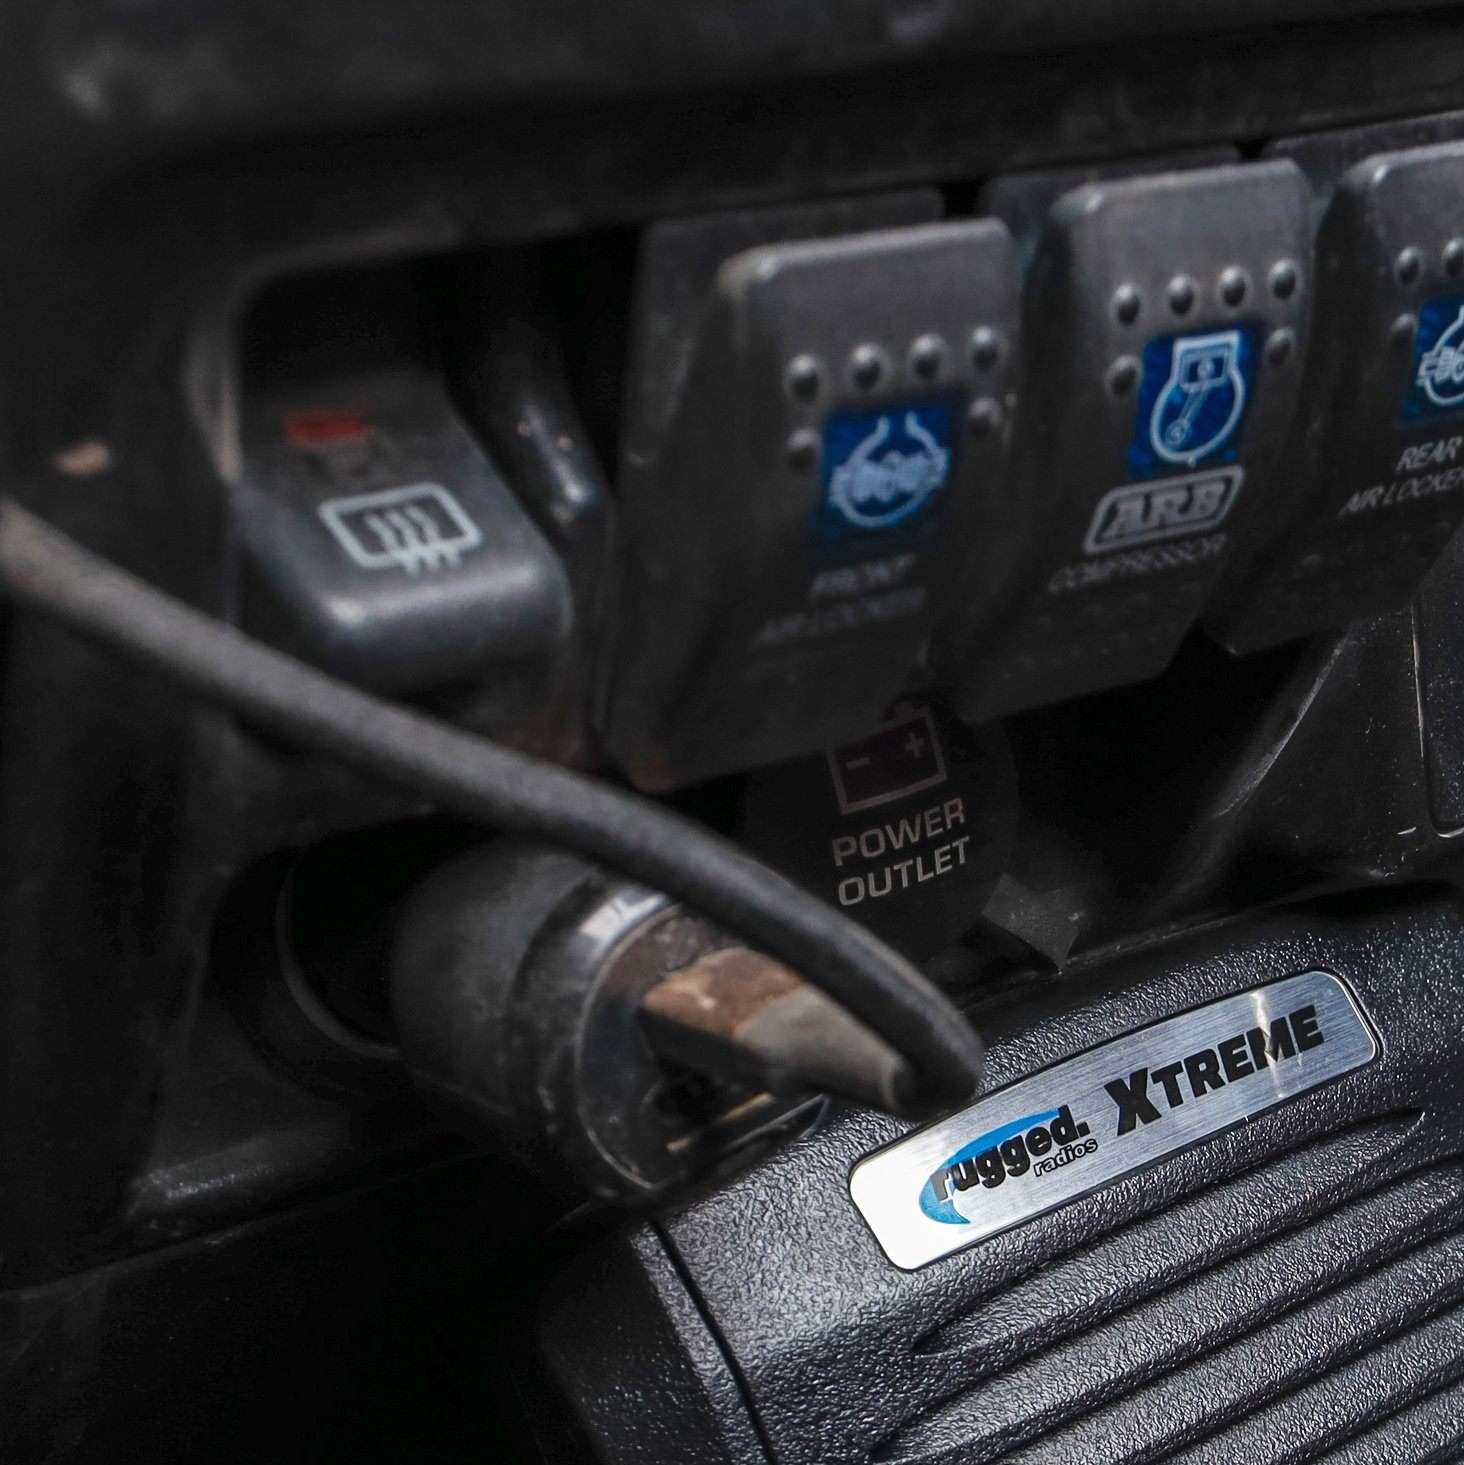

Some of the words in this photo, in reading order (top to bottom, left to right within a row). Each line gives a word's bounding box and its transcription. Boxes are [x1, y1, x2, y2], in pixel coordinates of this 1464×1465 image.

[1395, 435, 1463, 474] REAR
[1094, 477, 1233, 544] ARB
[832, 797, 966, 867] POWER
[838, 835, 970, 906] OUTLET
[1105, 1005, 1324, 1136] XTREME
[1033, 1138, 1098, 1177] radios
